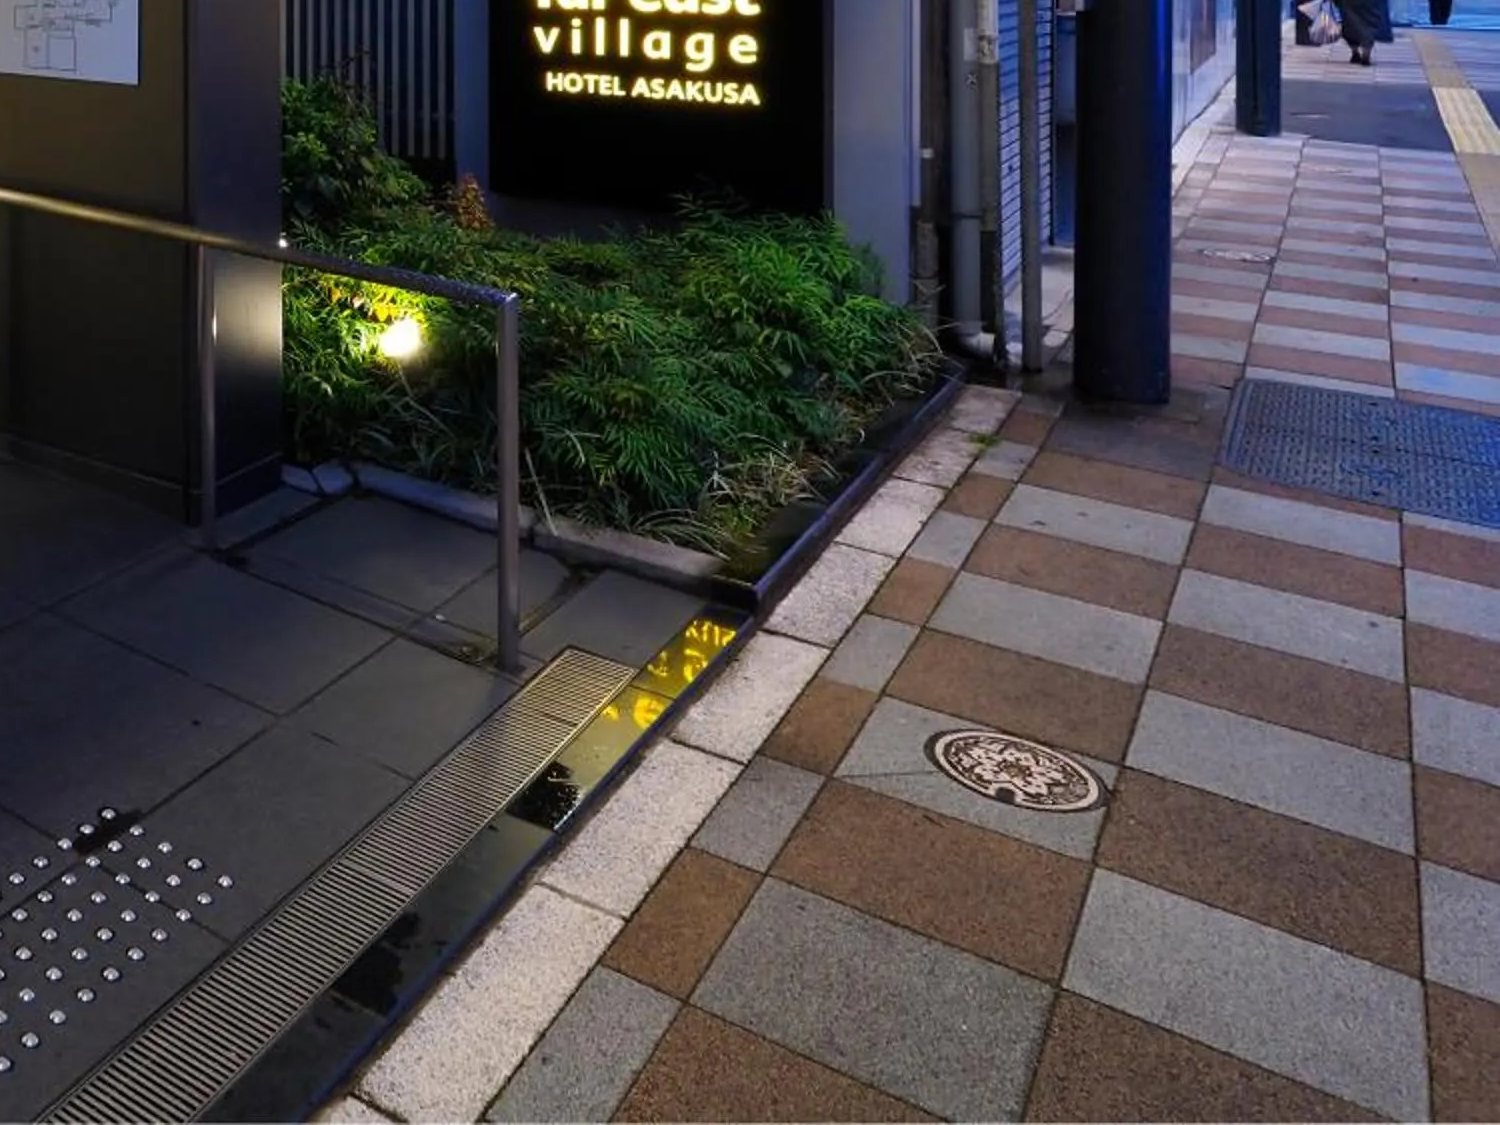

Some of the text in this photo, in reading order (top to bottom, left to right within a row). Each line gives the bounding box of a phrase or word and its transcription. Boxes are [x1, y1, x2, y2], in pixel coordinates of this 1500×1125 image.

[533, 17, 758, 72] village
[545, 71, 761, 106] HOTEL ASAKUSA
